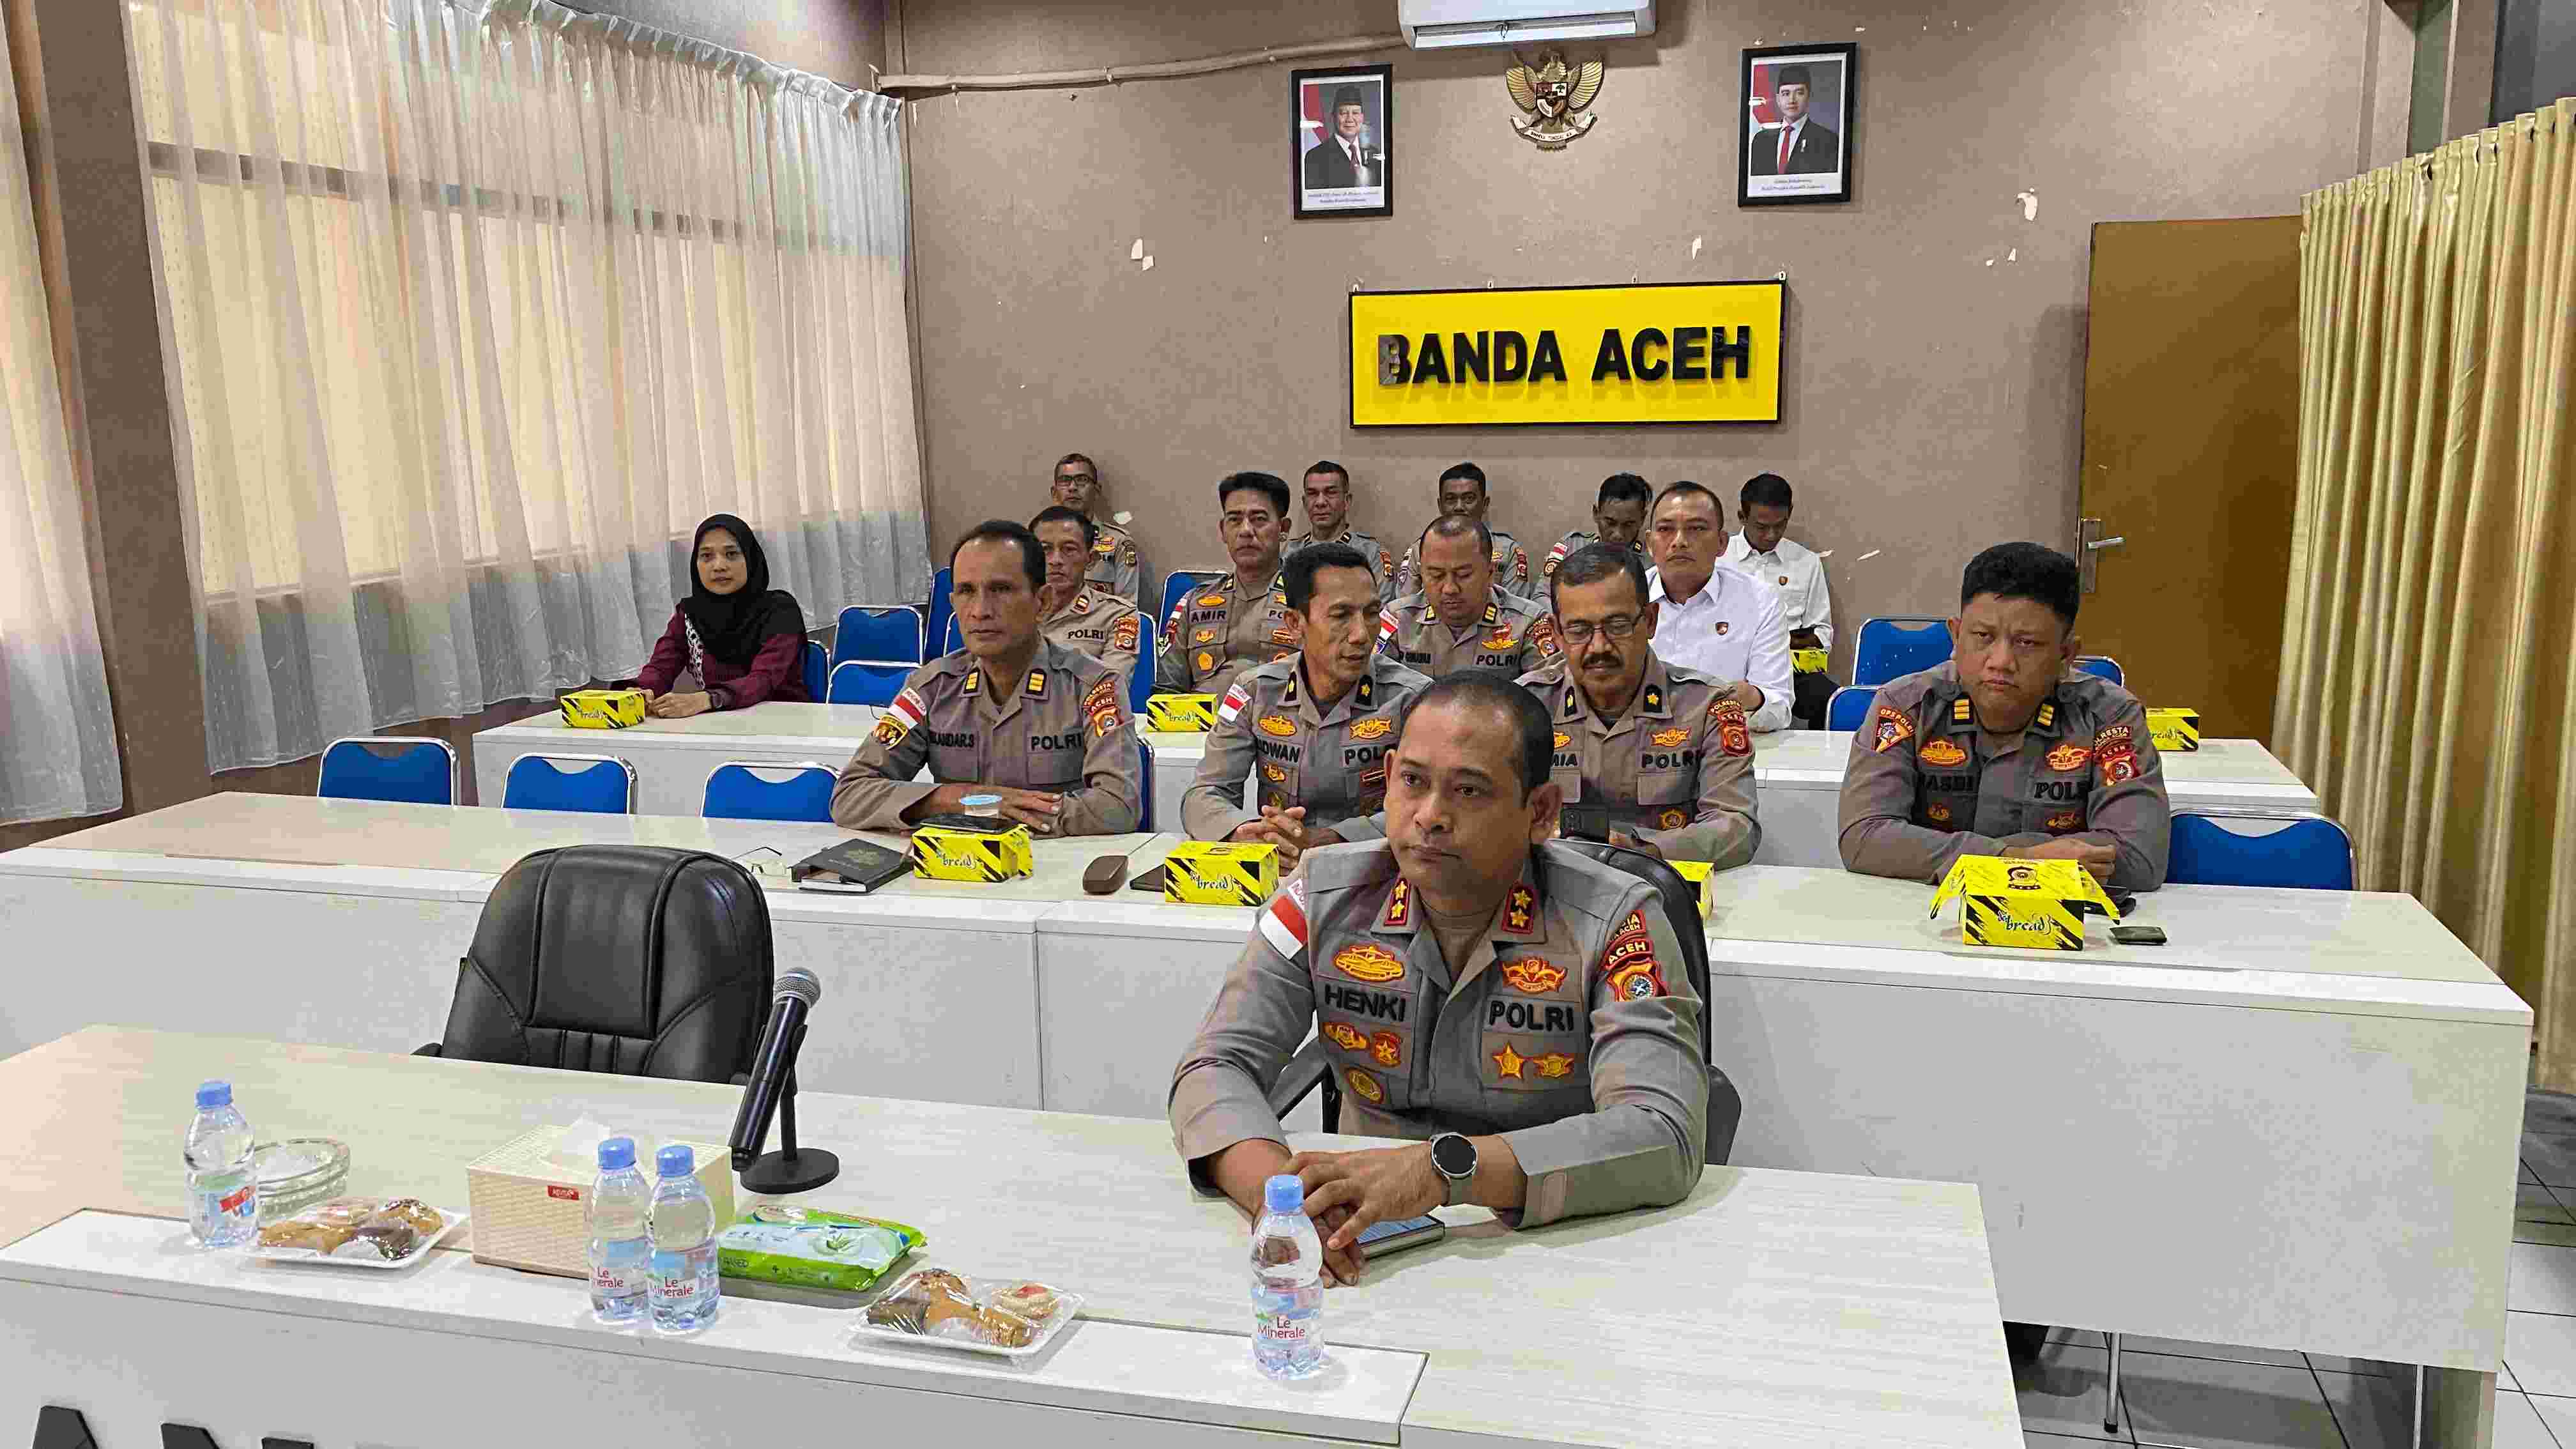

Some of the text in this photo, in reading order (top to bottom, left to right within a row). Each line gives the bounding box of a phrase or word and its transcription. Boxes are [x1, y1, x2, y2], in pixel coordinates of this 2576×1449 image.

[1378, 325, 1750, 385] BANDA ACEH
[1191, 610, 1227, 623] AMIR
[1068, 629, 1105, 640] POLRI
[1091, 697, 1112, 711] ACEH
[1880, 708, 1915, 733] OPS POLRI
[1031, 732, 1082, 751] POLRI
[1196, 875, 1228, 890] bread
[2006, 914, 2046, 931] bread
[1609, 941, 1646, 964] ACEH
[1324, 983, 1406, 1022] HENKI
[1489, 1000, 1574, 1031] POLRI
[597, 1267, 609, 1278] Le
[664, 1276, 678, 1288] Le
[1276, 1316, 1291, 1329] Le
[1257, 1323, 1305, 1338] Minerale
